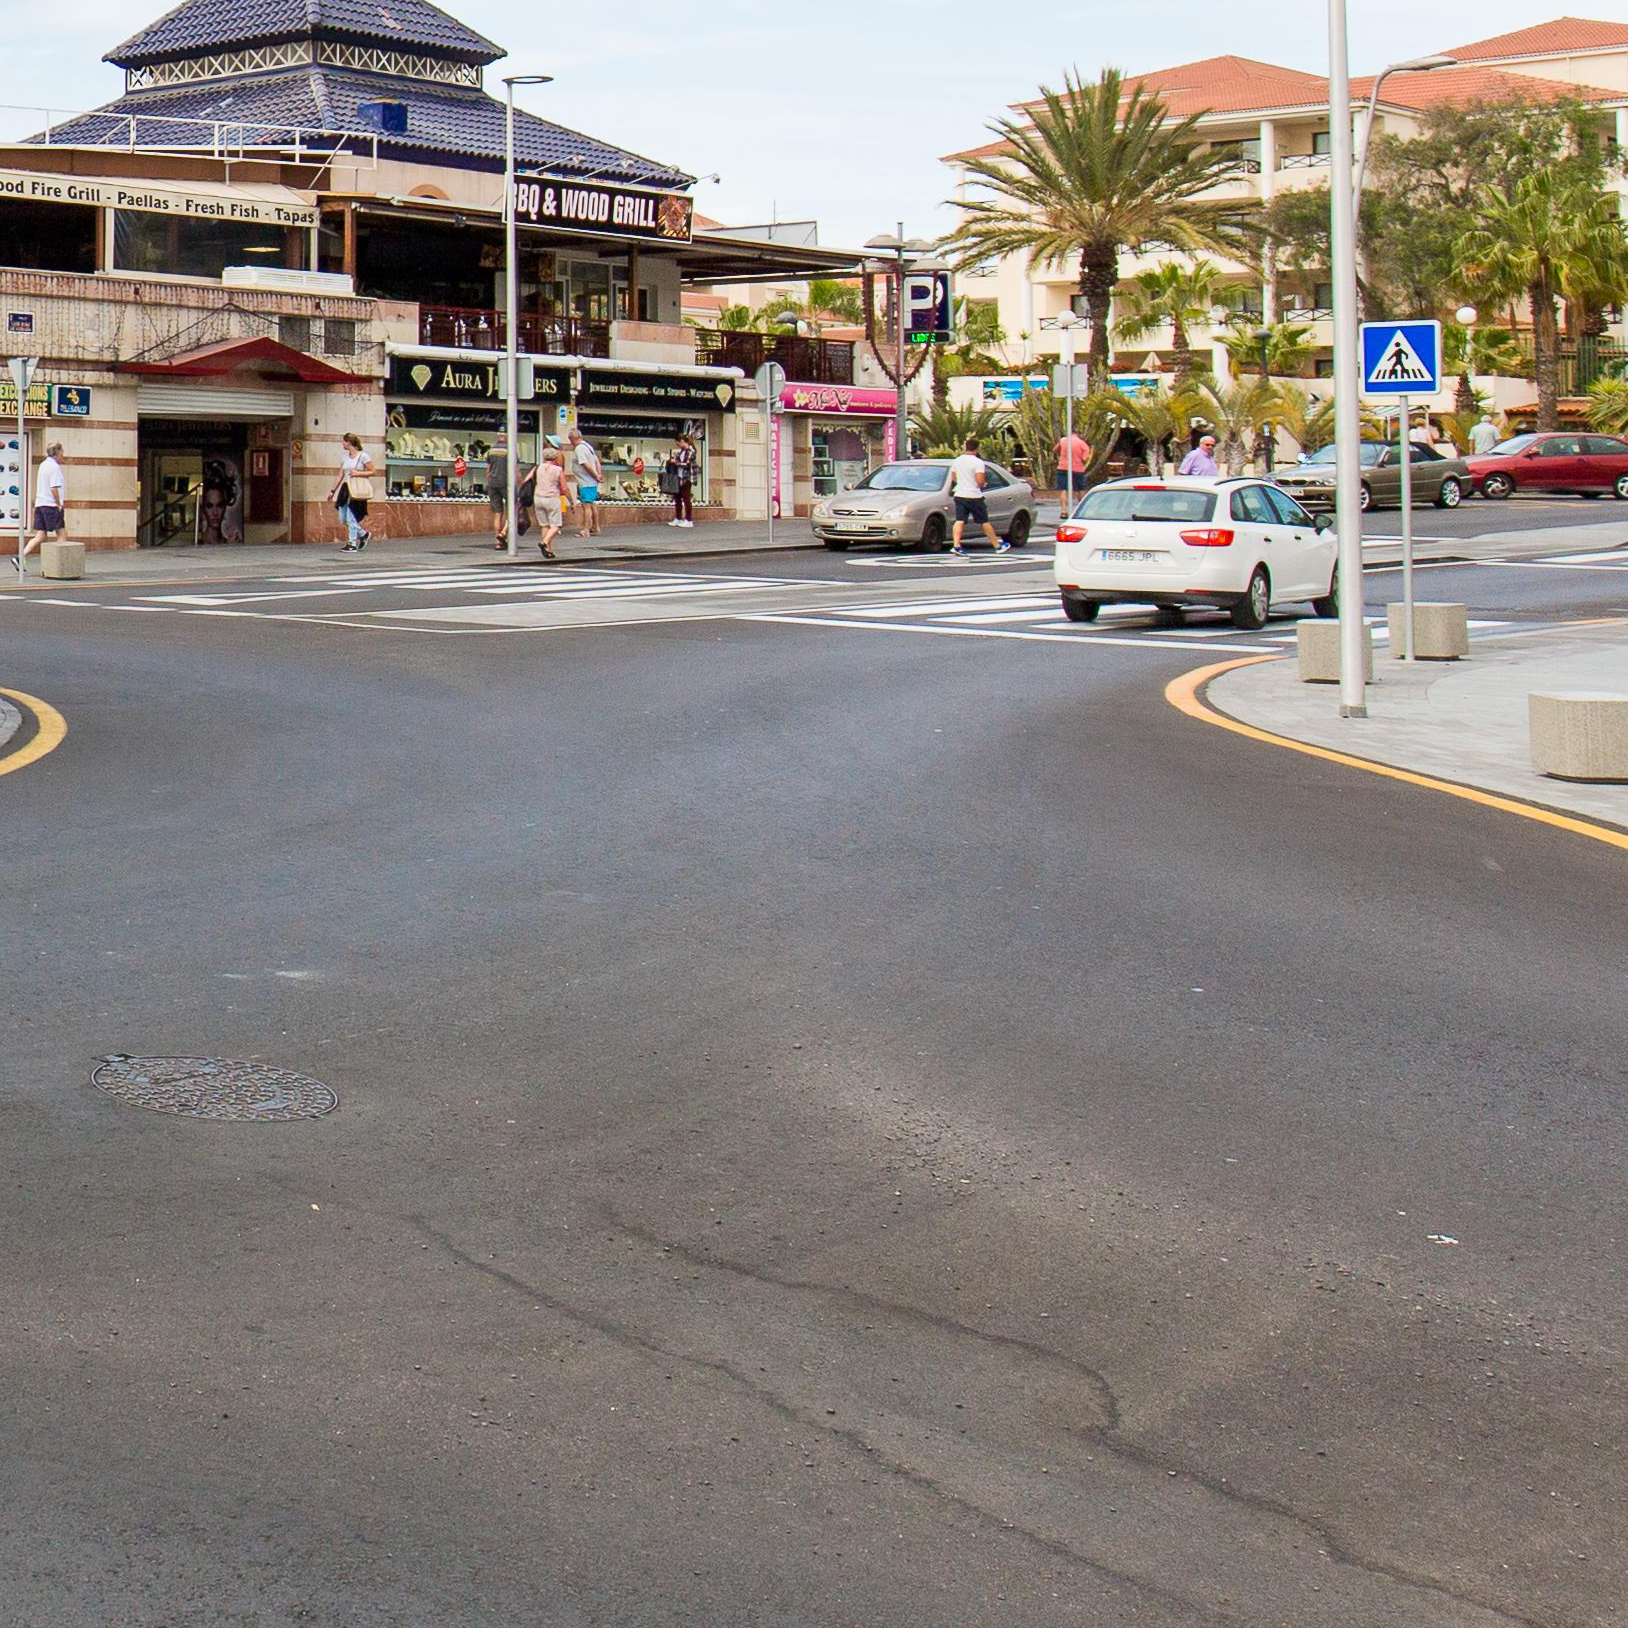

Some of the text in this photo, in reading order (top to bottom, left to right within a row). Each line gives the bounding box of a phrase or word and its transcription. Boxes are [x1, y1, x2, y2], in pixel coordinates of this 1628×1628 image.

[32, 181, 61, 198] Fire
[67, 185, 101, 203] Grill
[117, 191, 170, 210] Paellas
[185, 199, 224, 216] Fresh
[230, 203, 259, 219] Fish
[275, 207, 315, 226] Tapas
[543, 187, 556, 216] &
[562, 188, 609, 222] WOOD
[613, 195, 656, 228] GRILL
[904, 276, 944, 328] P
[441, 364, 482, 390] AURA
[0, 400, 48, 417] EXCANGE
[1108, 551, 1159, 563] 6665 JPL
